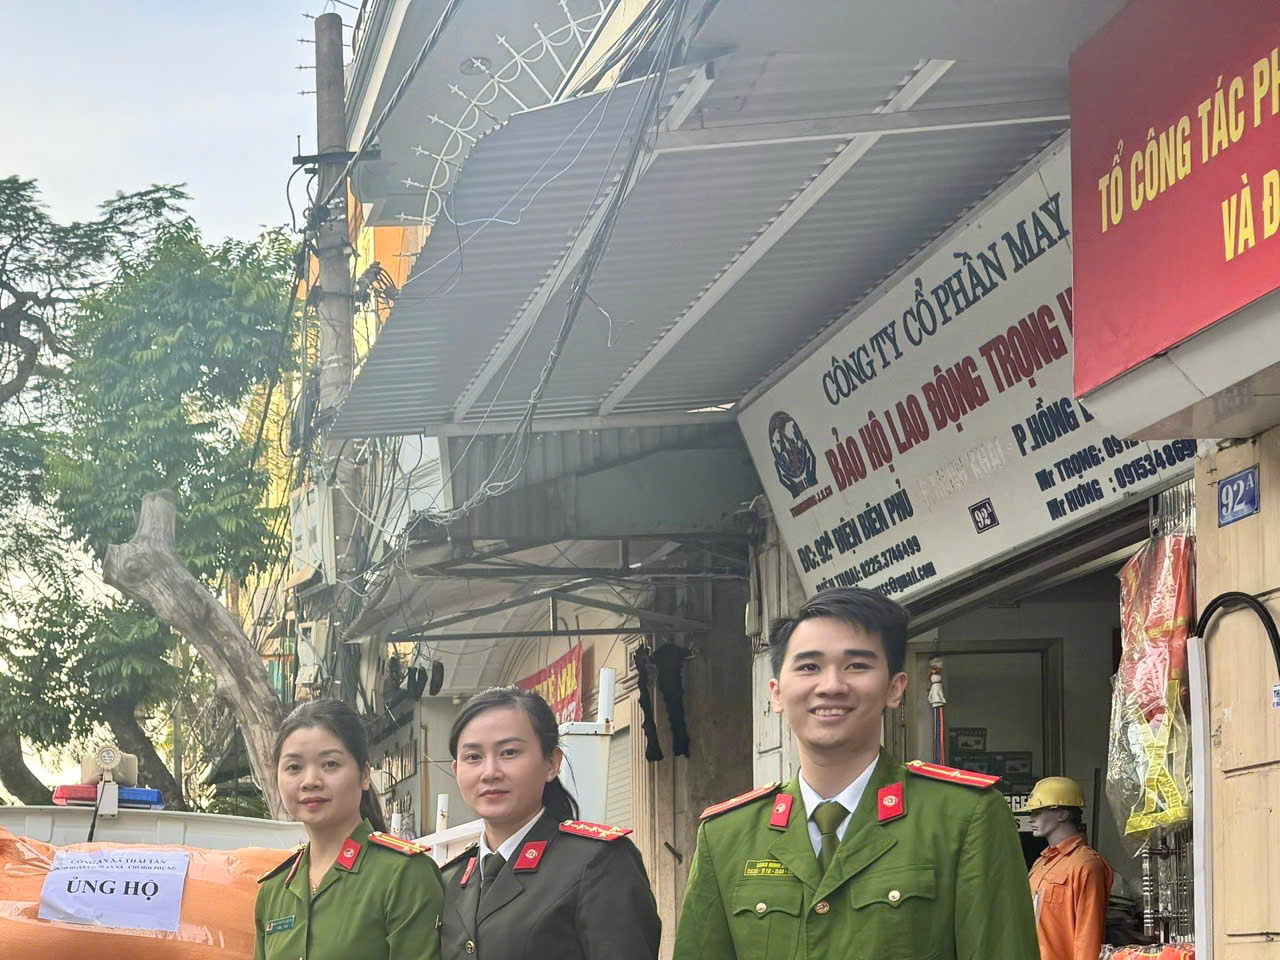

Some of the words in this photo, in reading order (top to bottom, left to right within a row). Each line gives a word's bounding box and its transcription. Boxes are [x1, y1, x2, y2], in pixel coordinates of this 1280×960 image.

[1098, 139, 1124, 233] TỔ
[1130, 115, 1192, 212] CÔNG
[1198, 74, 1245, 164] TÁC
[1221, 173, 1256, 262] VÀ
[822, 356, 878, 406] CÔNG
[869, 320, 904, 370] TY
[902, 277, 937, 346] CỔ
[931, 251, 1008, 326] PHẦN
[1001, 192, 1070, 274] MAY
[824, 426, 868, 493] BẢO
[858, 410, 895, 473] HỘ
[884, 394, 930, 455] LAO
[921, 364, 990, 433] ĐỘNG
[978, 304, 1069, 393] TRỌNG
[831, 516, 863, 555] ĐIỆN
[857, 502, 890, 541] BIÊN
[883, 478, 914, 526] PHỦ
[1035, 468, 1056, 492] Mr
[1046, 497, 1067, 520] Mr
[1064, 478, 1105, 513] HƯNG
[1221, 473, 1255, 516] 92A
[66, 876, 116, 895] ỦNG
[123, 879, 159, 901] HỘ
